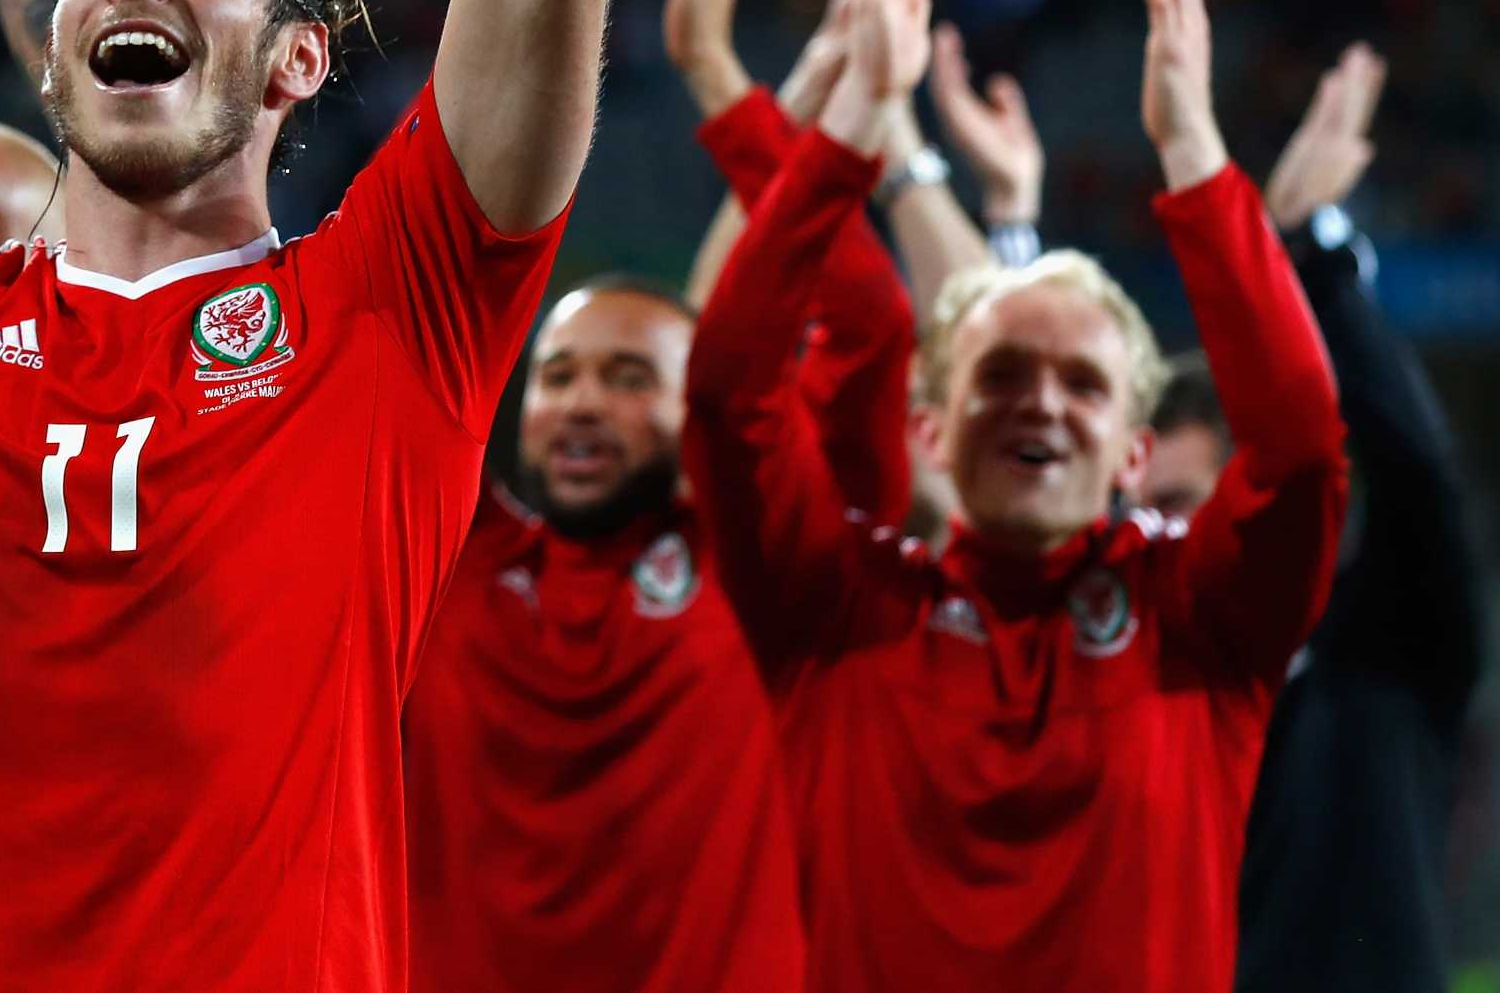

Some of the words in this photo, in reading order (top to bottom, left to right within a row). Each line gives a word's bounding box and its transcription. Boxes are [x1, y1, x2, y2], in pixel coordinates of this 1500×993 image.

[204, 384, 237, 399] WALES
[237, 381, 251, 392] VS
[251, 373, 283, 388] BELG
[41, 416, 156, 553] 11
